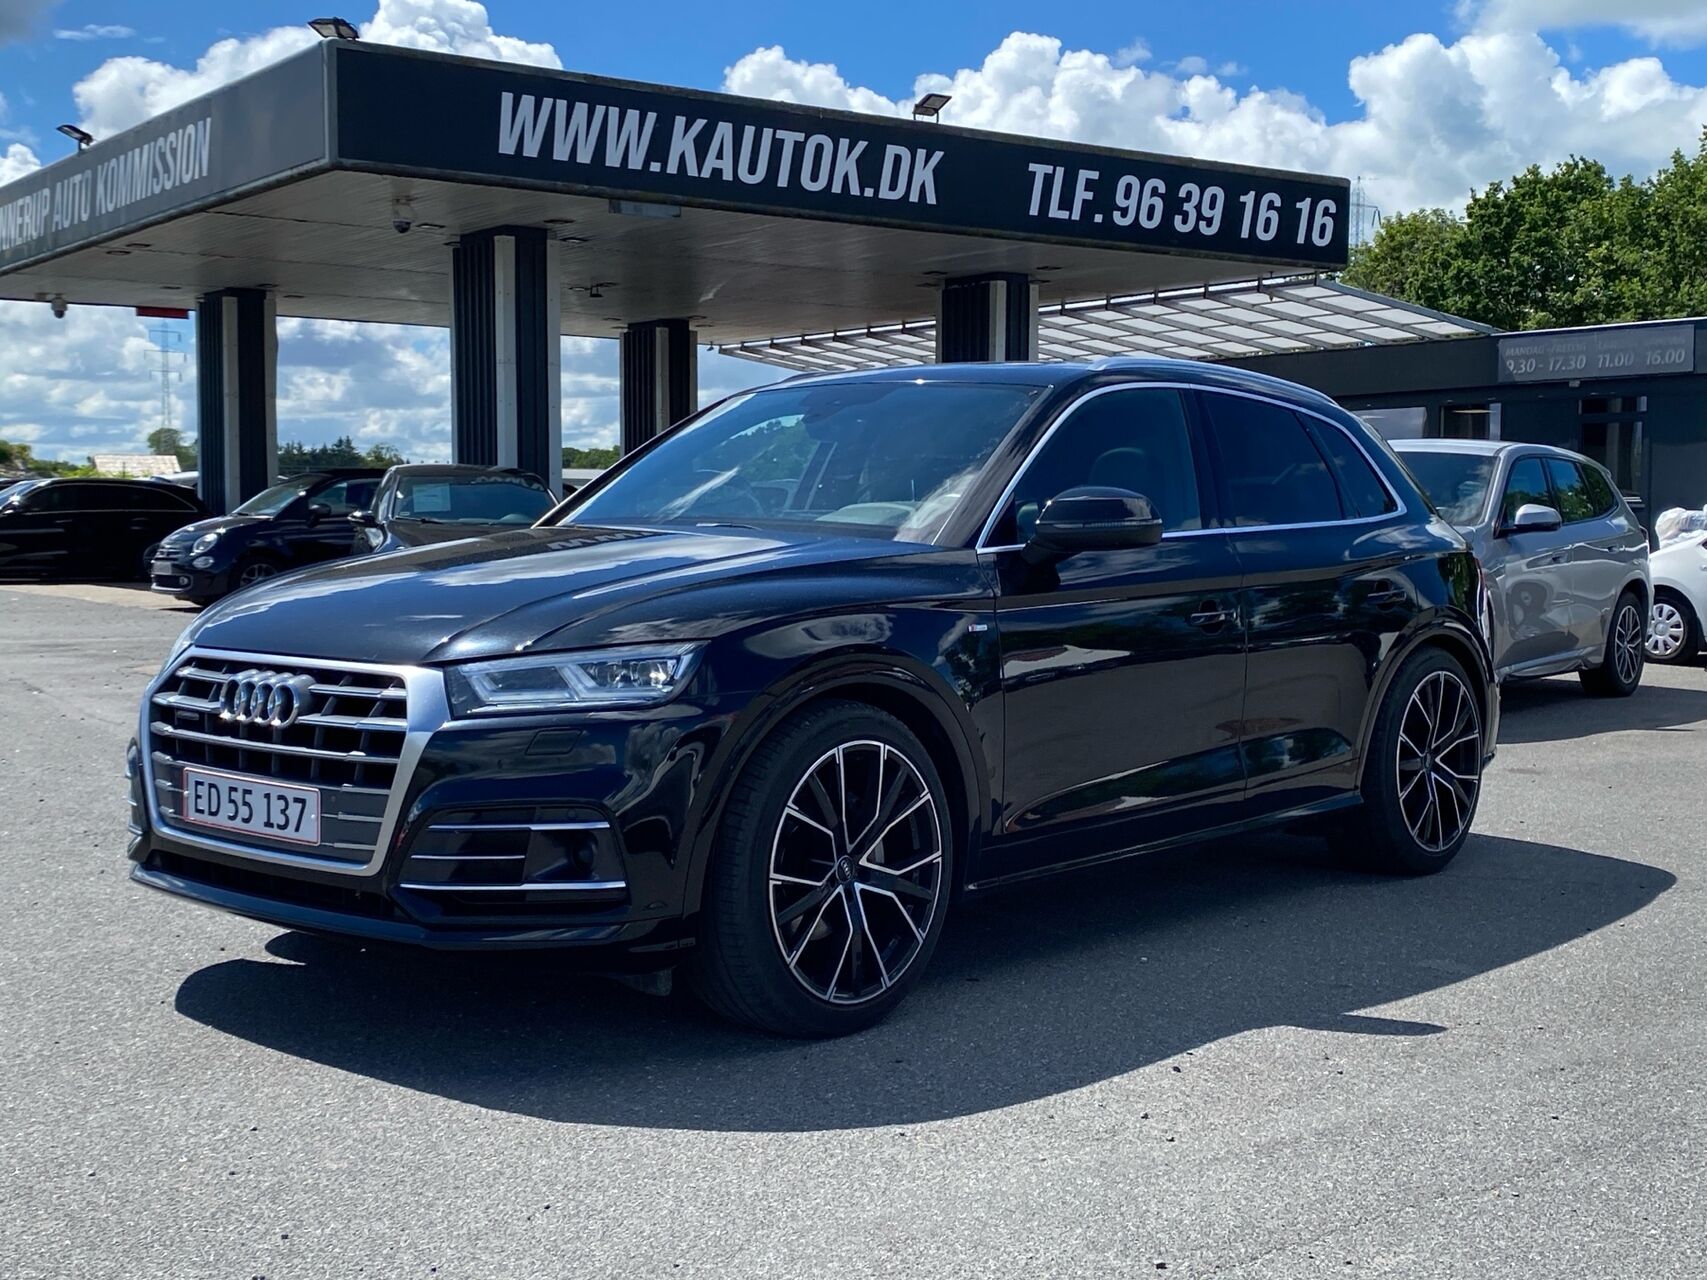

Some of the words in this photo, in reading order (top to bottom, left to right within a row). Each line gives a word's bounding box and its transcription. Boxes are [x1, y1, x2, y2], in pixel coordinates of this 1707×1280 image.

[52, 169, 92, 232] AUTO
[95, 117, 212, 216] KOMMISSION
[498, 91, 945, 205] WWW.KAUTOK.DK
[1028, 162, 1104, 223] TLF.
[1112, 174, 1166, 229] 96
[1173, 182, 1225, 236] 39
[1239, 190, 1281, 241] 16
[1295, 197, 1337, 247] 16
[1506, 358, 1536, 375] 9.30
[1549, 354, 1587, 372] 17.30
[1598, 352, 1634, 369] 11.00
[194, 780, 221, 817] ED
[227, 786, 254, 825] 55
[263, 792, 307, 833] 137
